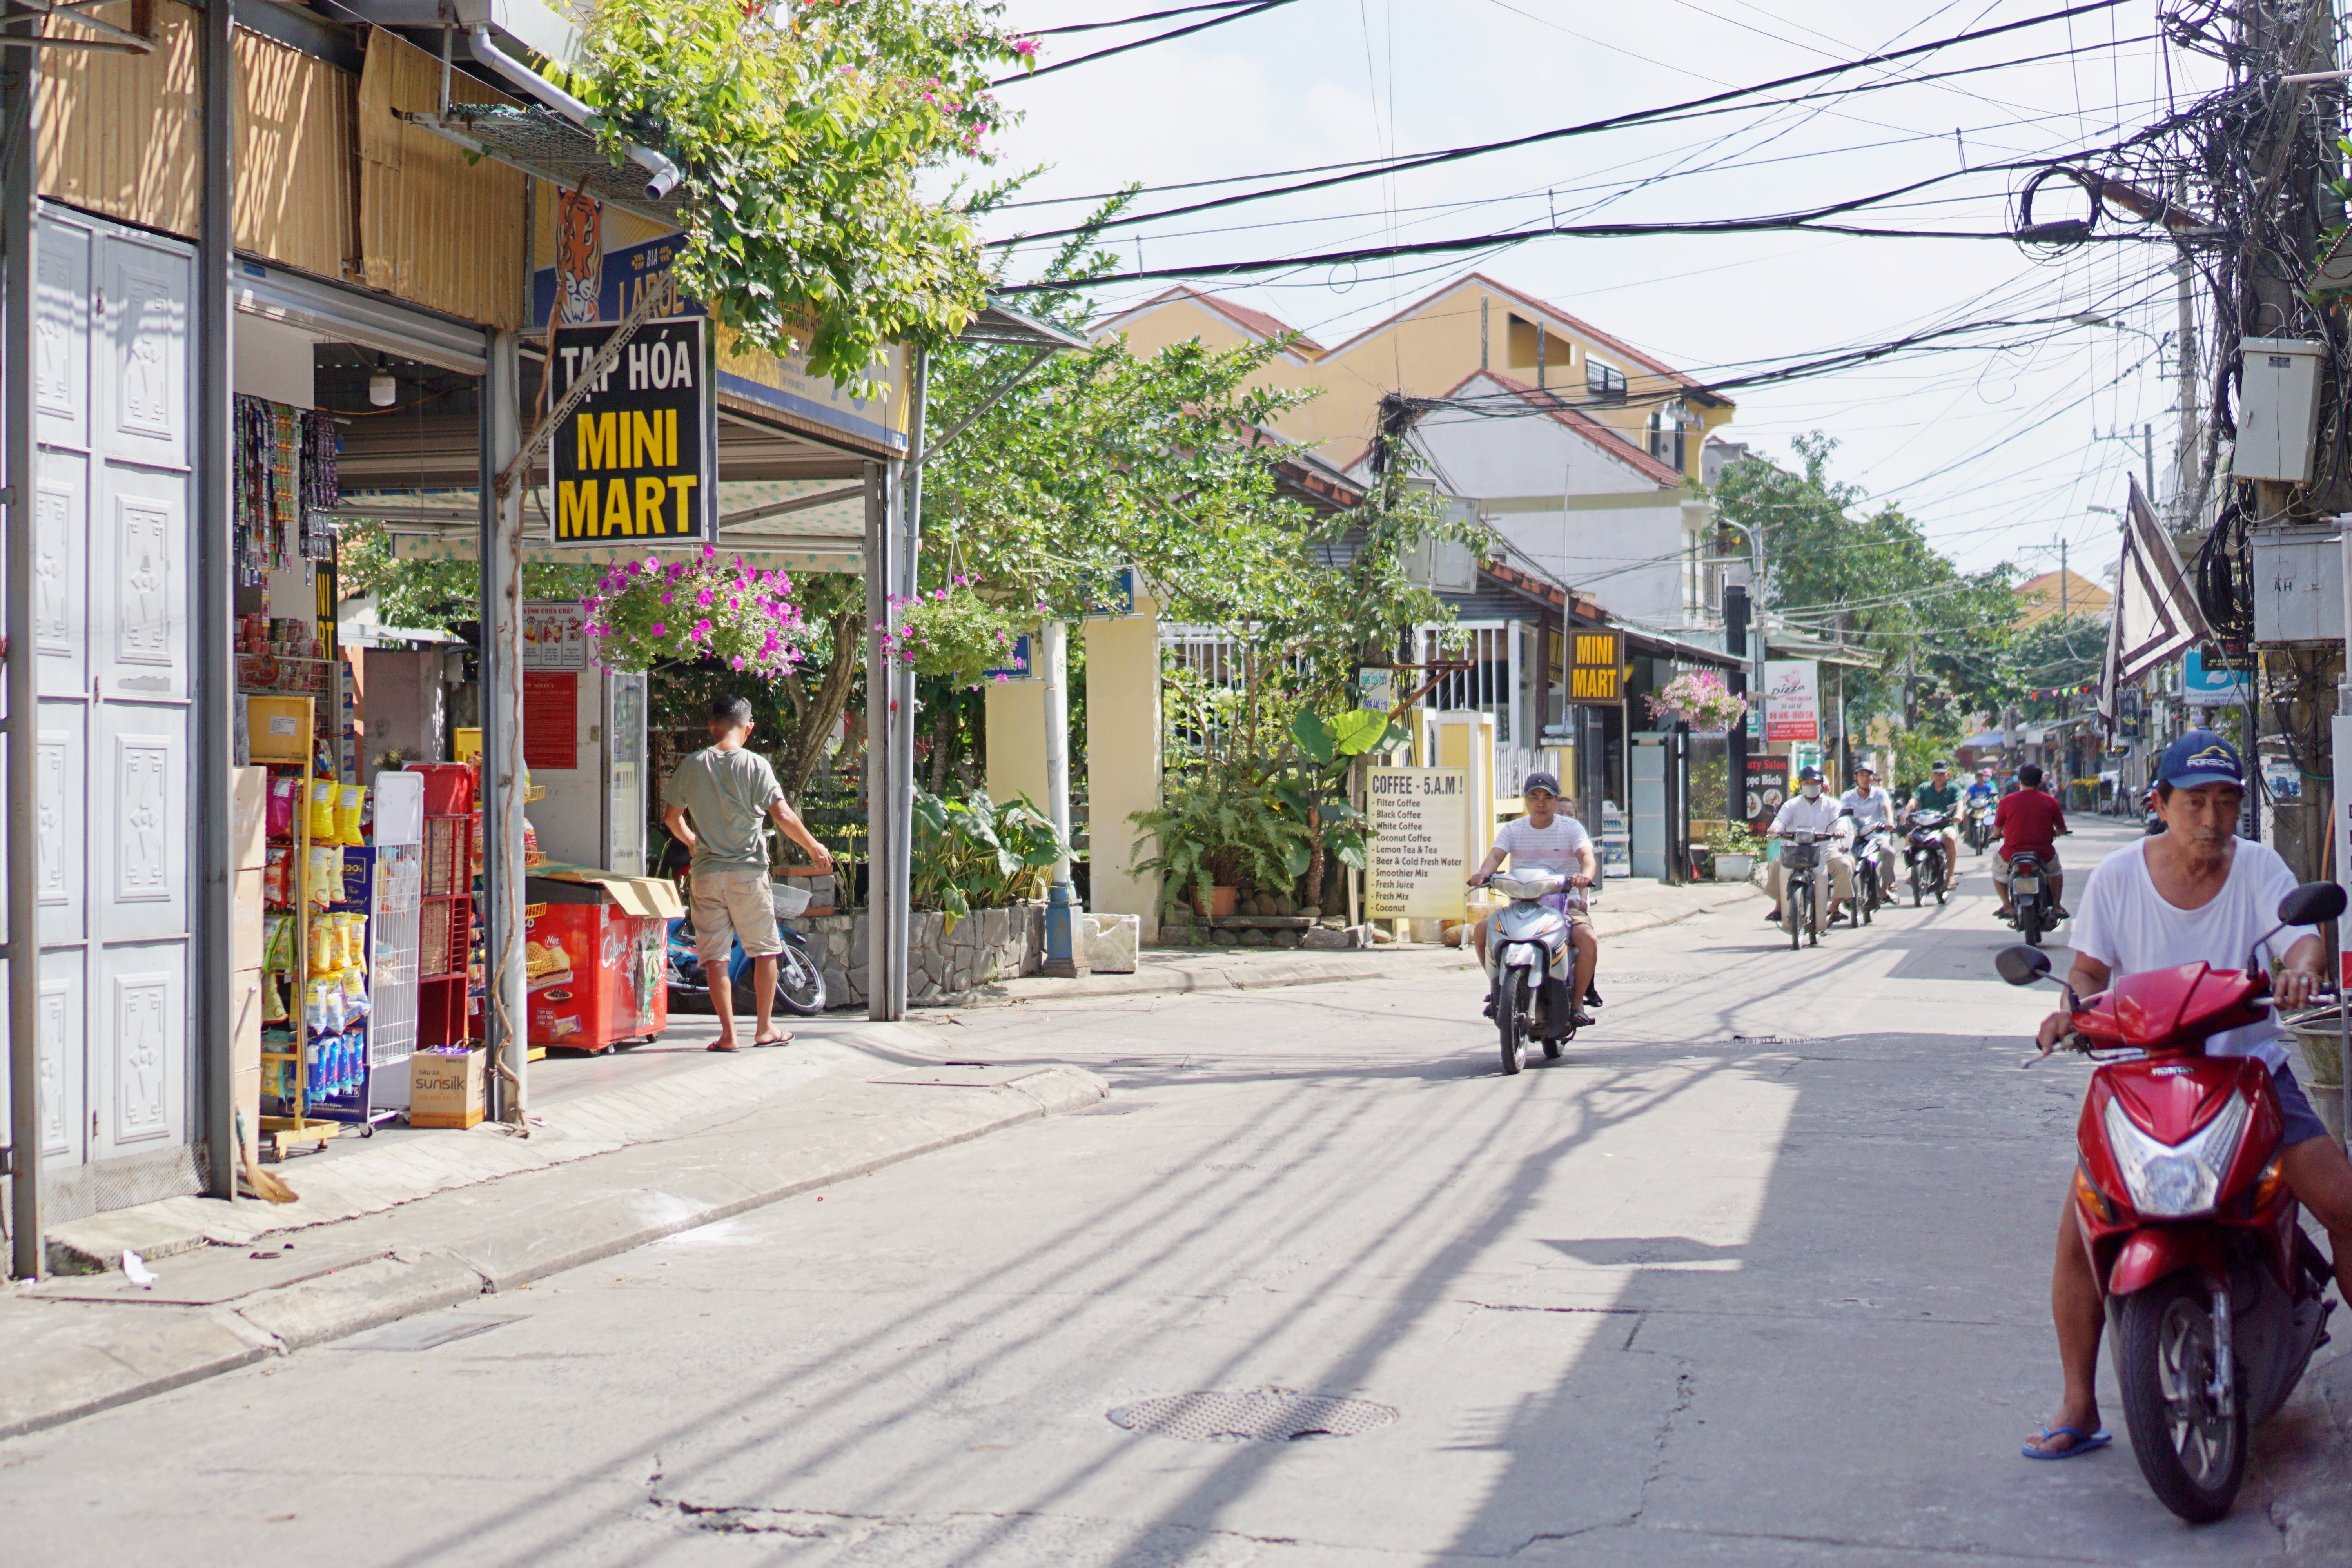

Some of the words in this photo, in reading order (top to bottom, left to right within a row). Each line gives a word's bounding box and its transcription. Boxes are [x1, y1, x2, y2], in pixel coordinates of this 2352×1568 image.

[646, 248, 658, 267] BIA
[628, 330, 693, 390] HÓA
[577, 409, 678, 470] MINI
[559, 475, 697, 538] MART
[1577, 636, 1613, 664] MINI
[1573, 669, 1616, 697] MART
[1764, 760, 1787, 770] Salon
[1372, 775, 1412, 794] COFFEE
[1423, 776, 1455, 795] 5.A.M
[1761, 774, 1782, 786] Bích
[1377, 798, 1395, 807] Filter
[1397, 799, 1421, 808] Coffee
[1376, 810, 1396, 818] Black
[1397, 810, 1421, 819] Coffee
[1376, 822, 1397, 830] White
[1399, 822, 1422, 831] Coffee
[1377, 834, 1406, 842] Coconut
[1408, 834, 1432, 842] Coffee
[1376, 845, 1401, 854] Lemon
[1403, 846, 1415, 854] Tea
[1417, 846, 1423, 854] &
[1425, 846, 1437, 854] Tea
[1376, 857, 1393, 865] Beer
[1394, 857, 1400, 865] &
[1402, 857, 1418, 866] Cold
[1420, 857, 1439, 866] Fresh
[1441, 858, 1462, 866] Water
[1376, 868, 1413, 877] Smoothier
[1415, 869, 1428, 877] Mix
[1376, 880, 1394, 889] Fresh
[1396, 880, 1414, 889] Juice
[1376, 892, 1394, 900] Fresh
[1396, 892, 1409, 900] Mix
[1376, 903, 1405, 912] Coconut
[547, 936, 559, 944] Hot
[602, 931, 627, 968] Celano
[416, 1075, 465, 1090] sunsilk
